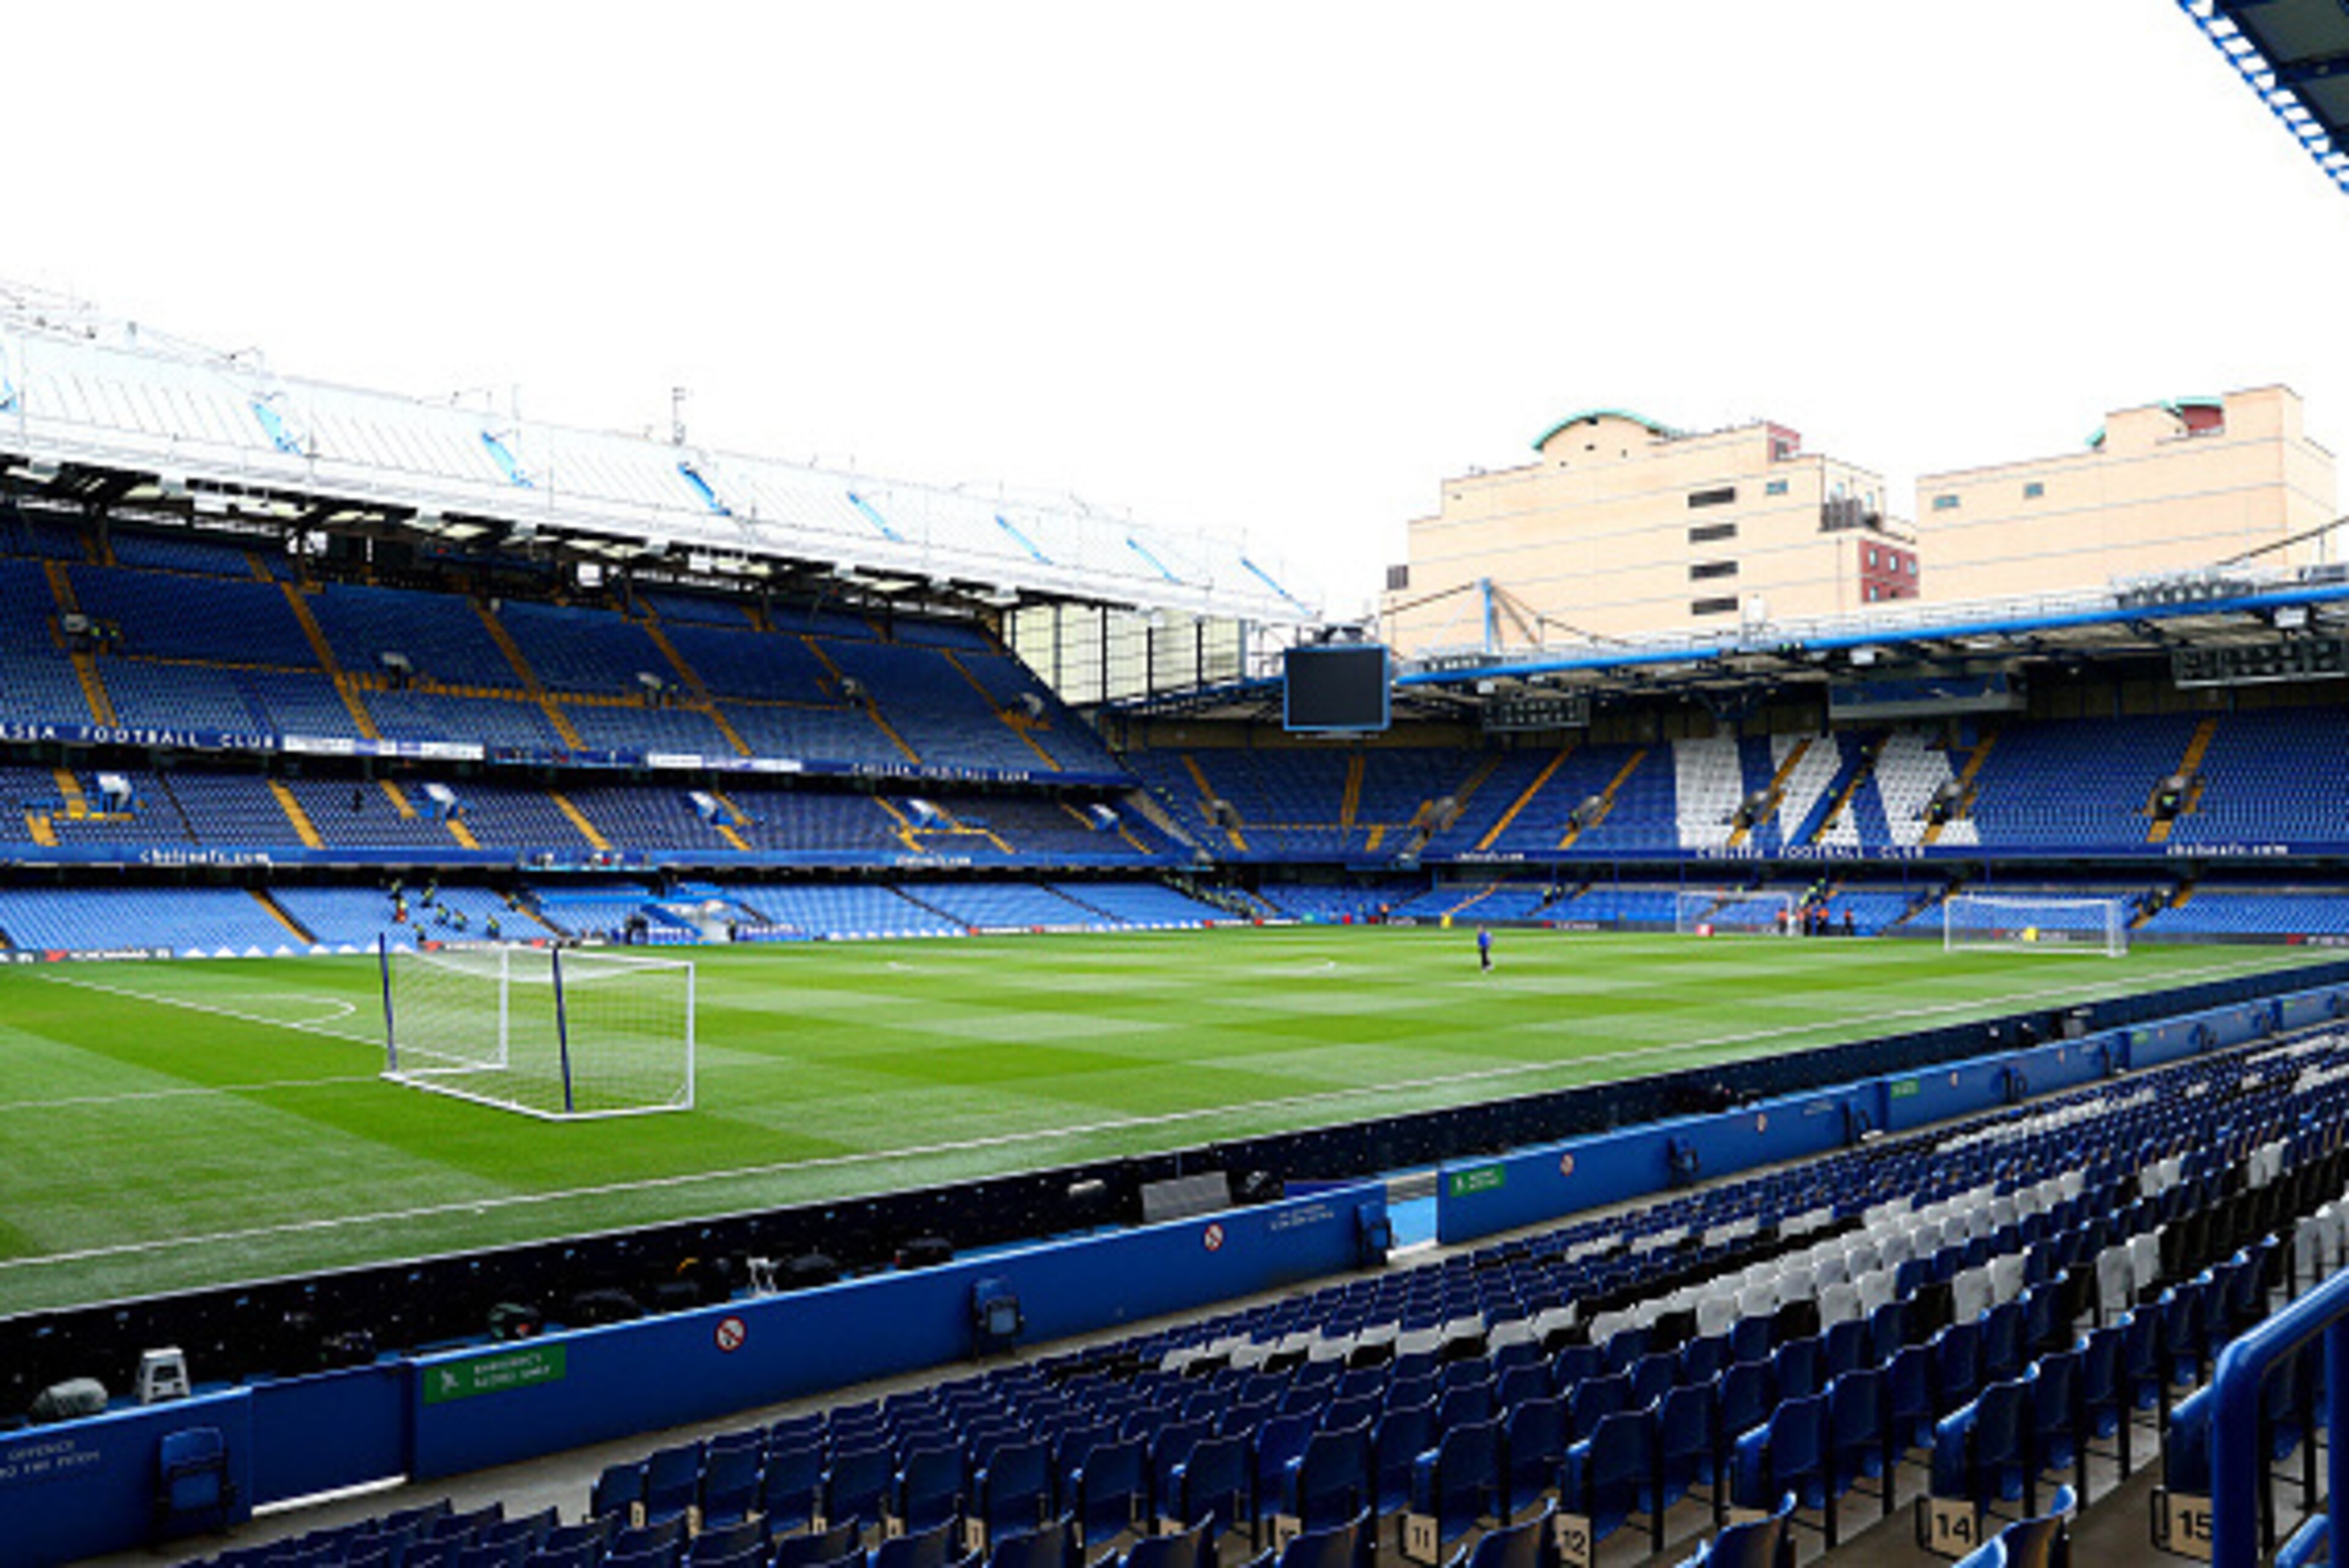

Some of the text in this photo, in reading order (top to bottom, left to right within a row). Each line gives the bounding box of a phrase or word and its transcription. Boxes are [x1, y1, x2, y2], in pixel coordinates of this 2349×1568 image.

[81, 726, 199, 747] FOOTBALL
[1935, 1513, 1970, 1544] 14
[2178, 1510, 2213, 1540] 15
[1563, 1529, 1586, 1556] 12
